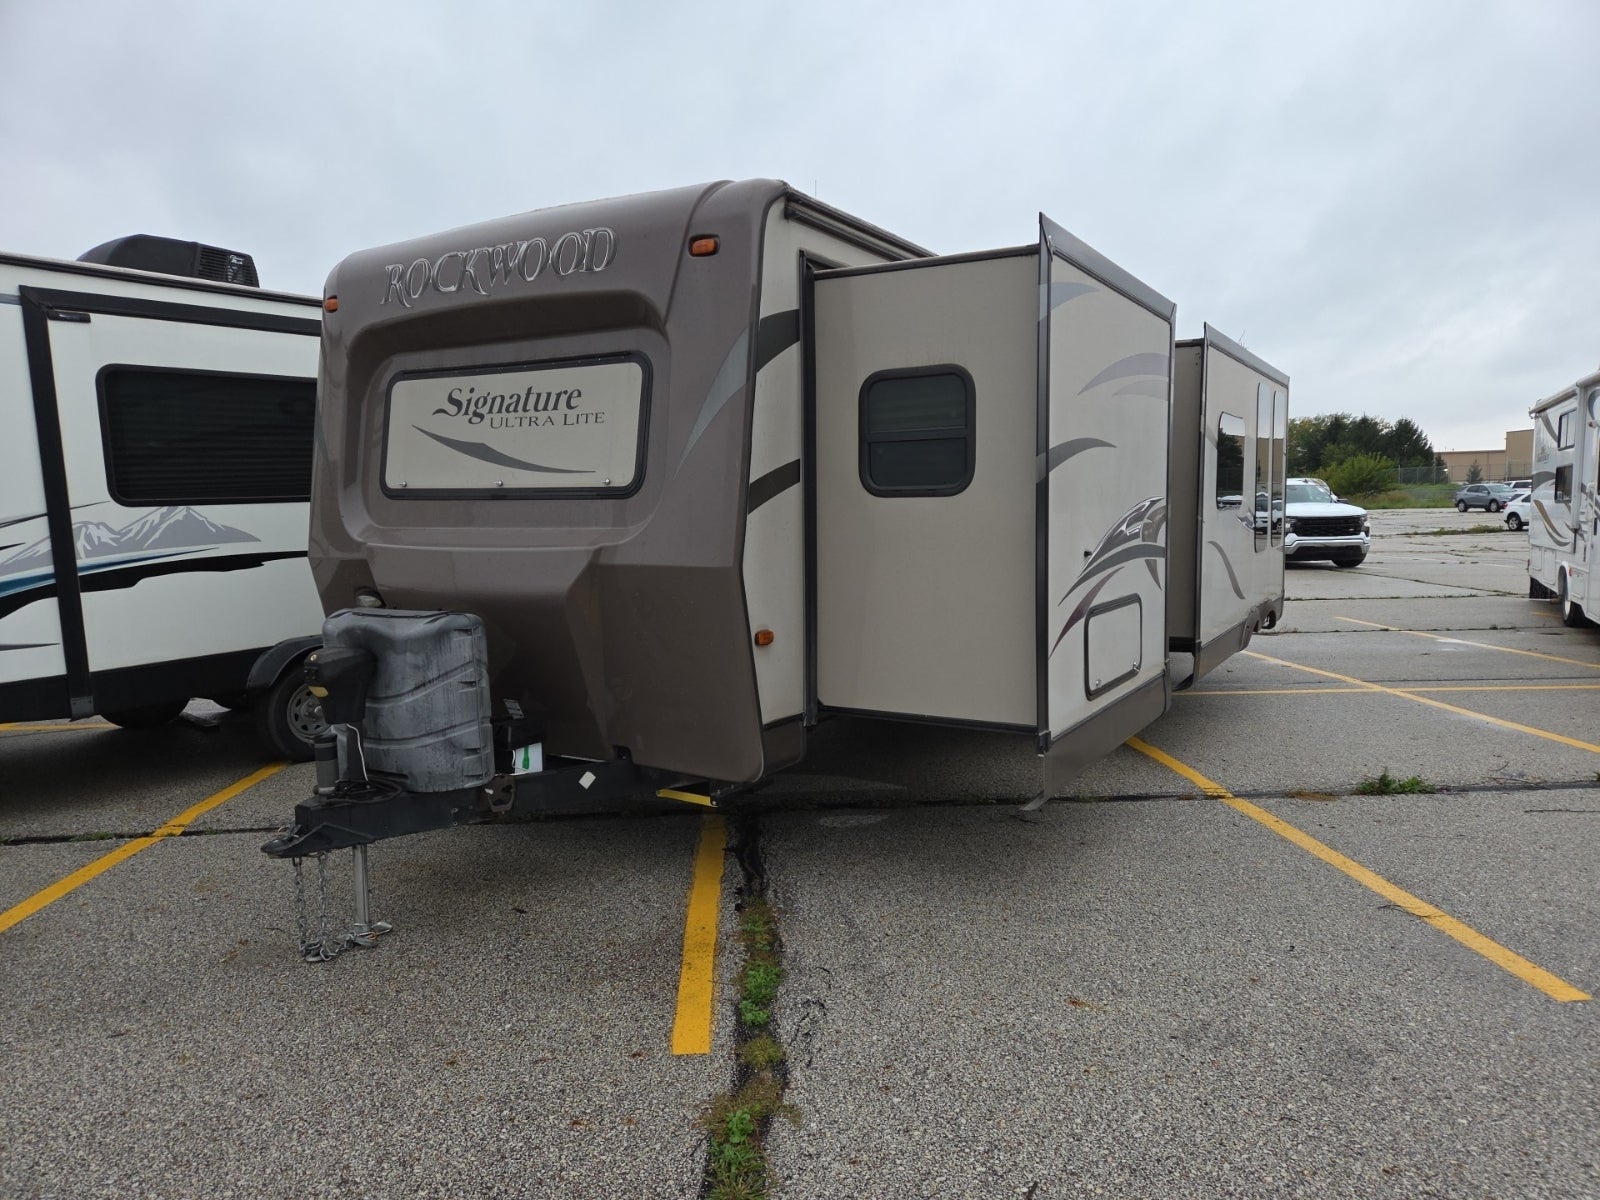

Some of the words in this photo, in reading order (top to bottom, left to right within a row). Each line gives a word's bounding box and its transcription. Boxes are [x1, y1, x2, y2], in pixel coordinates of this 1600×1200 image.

[381, 227, 617, 307] ROCKWOOD
[432, 386, 582, 424] Signature
[490, 414, 555, 429] ULTRA
[563, 412, 605, 426] LITE
